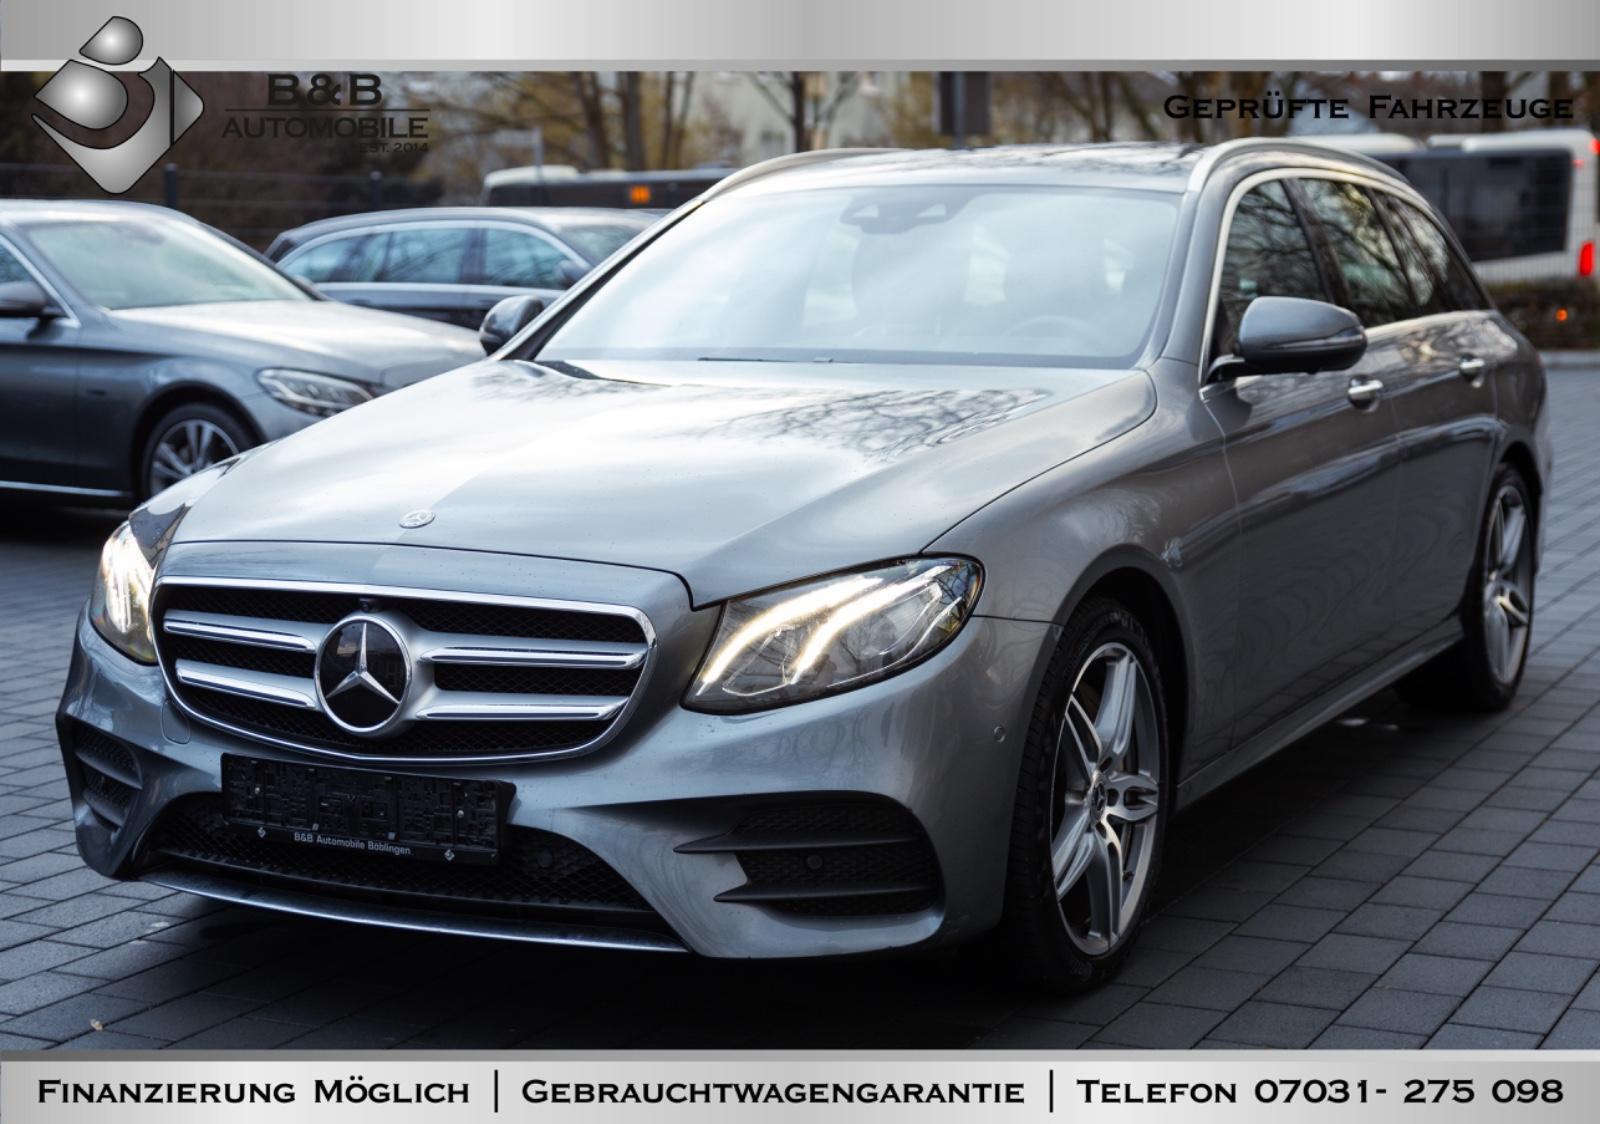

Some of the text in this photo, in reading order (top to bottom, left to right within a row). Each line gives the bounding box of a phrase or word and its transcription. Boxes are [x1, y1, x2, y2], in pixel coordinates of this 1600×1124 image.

[294, 831, 411, 856] B&B Automobile Böblingen
